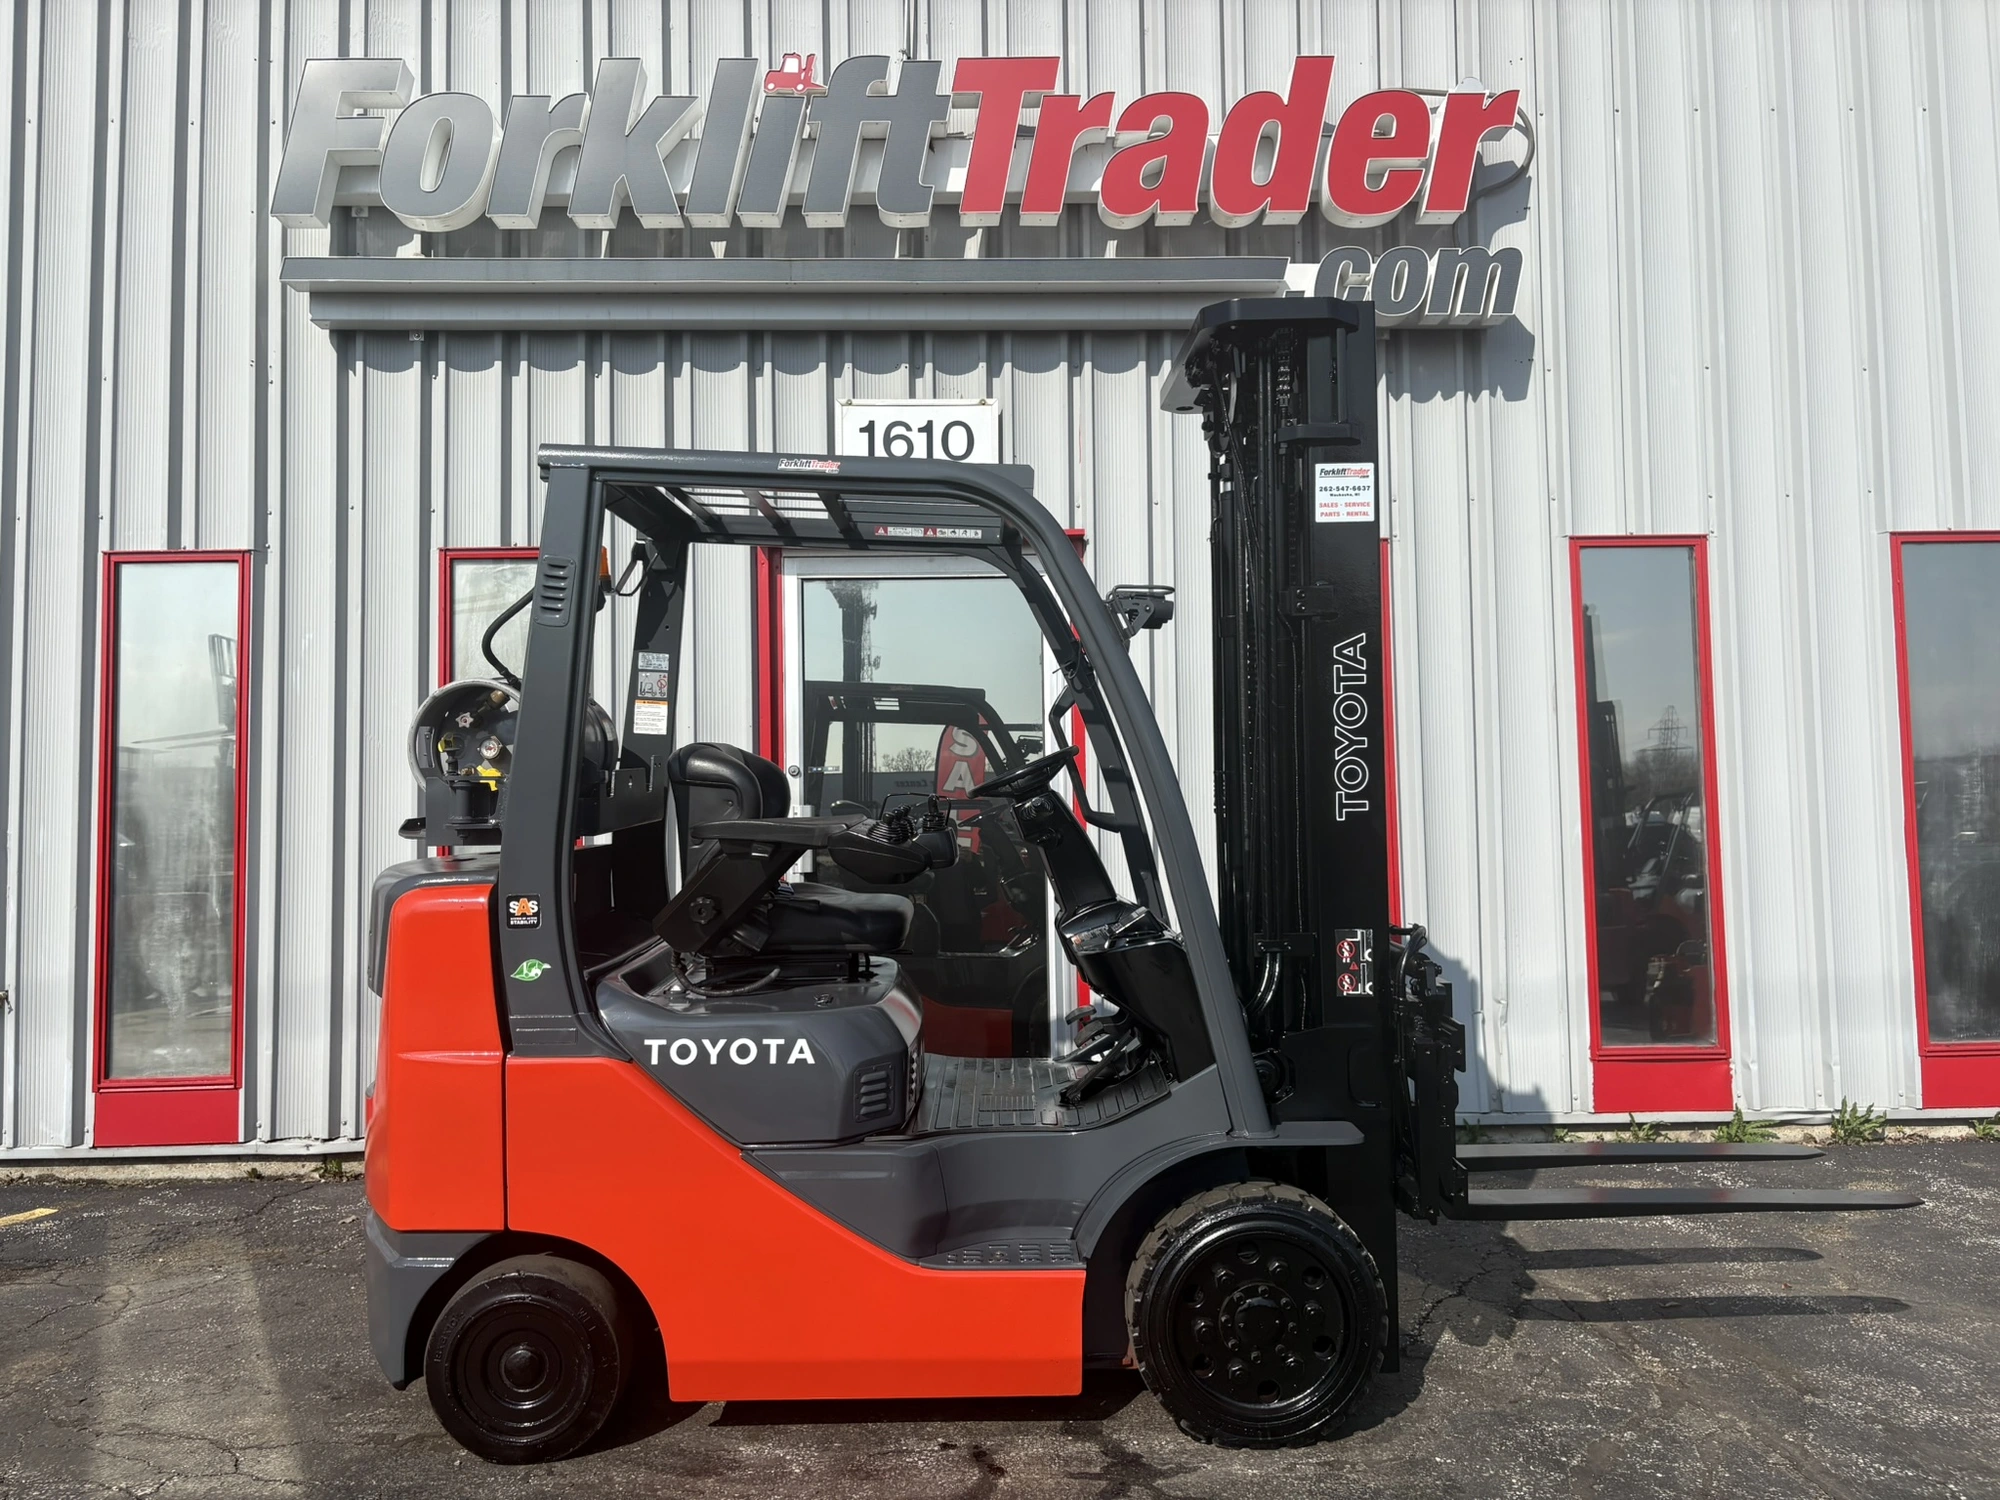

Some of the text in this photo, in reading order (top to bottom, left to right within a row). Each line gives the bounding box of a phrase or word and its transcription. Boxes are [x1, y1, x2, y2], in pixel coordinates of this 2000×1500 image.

[270, 54, 1520, 222] ForkliftTrader
[859, 420, 975, 461] 1610
[779, 459, 841, 469] ForkliftTrader
[1319, 468, 1371, 476] ForkliftTrader
[1333, 632, 1369, 821] TOYOTA
[509, 897, 539, 916] SAS
[643, 1037, 816, 1066] TOYOTA
